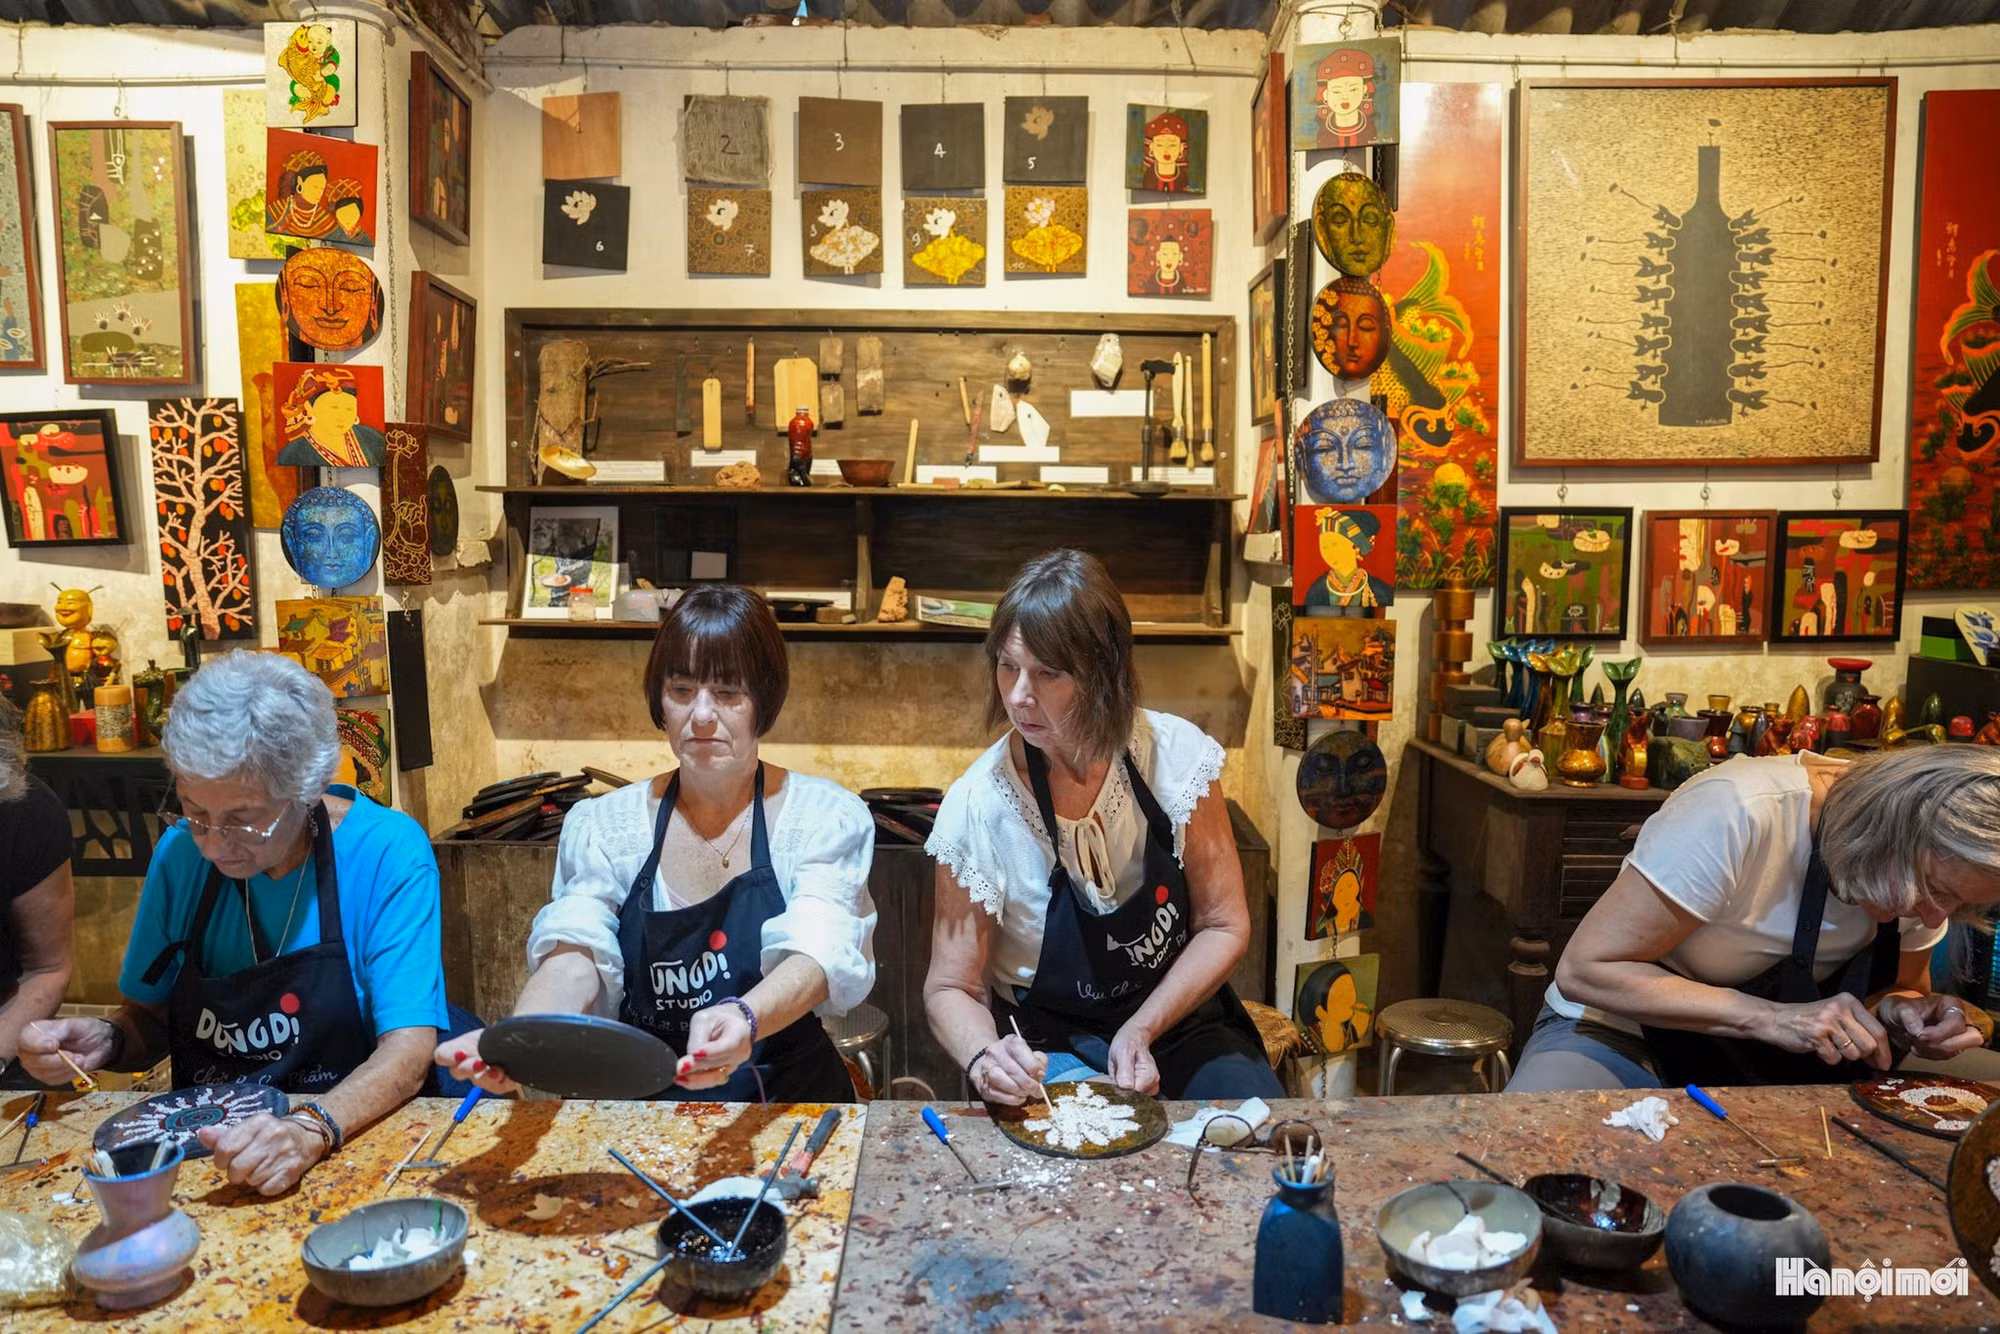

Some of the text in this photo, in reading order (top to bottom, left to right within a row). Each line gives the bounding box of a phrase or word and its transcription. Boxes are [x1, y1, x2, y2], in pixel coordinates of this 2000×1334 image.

[720, 134, 741, 155] 2
[834, 132, 845, 151] 3
[934, 142, 946, 158] 4
[1027, 156, 1037, 169] 5
[595, 241, 604, 251] 6
[912, 232, 921, 247] 9
[744, 243, 755, 255] 7
[1011, 261, 1025, 270] 10
[656, 989, 712, 1011] STUDIO
